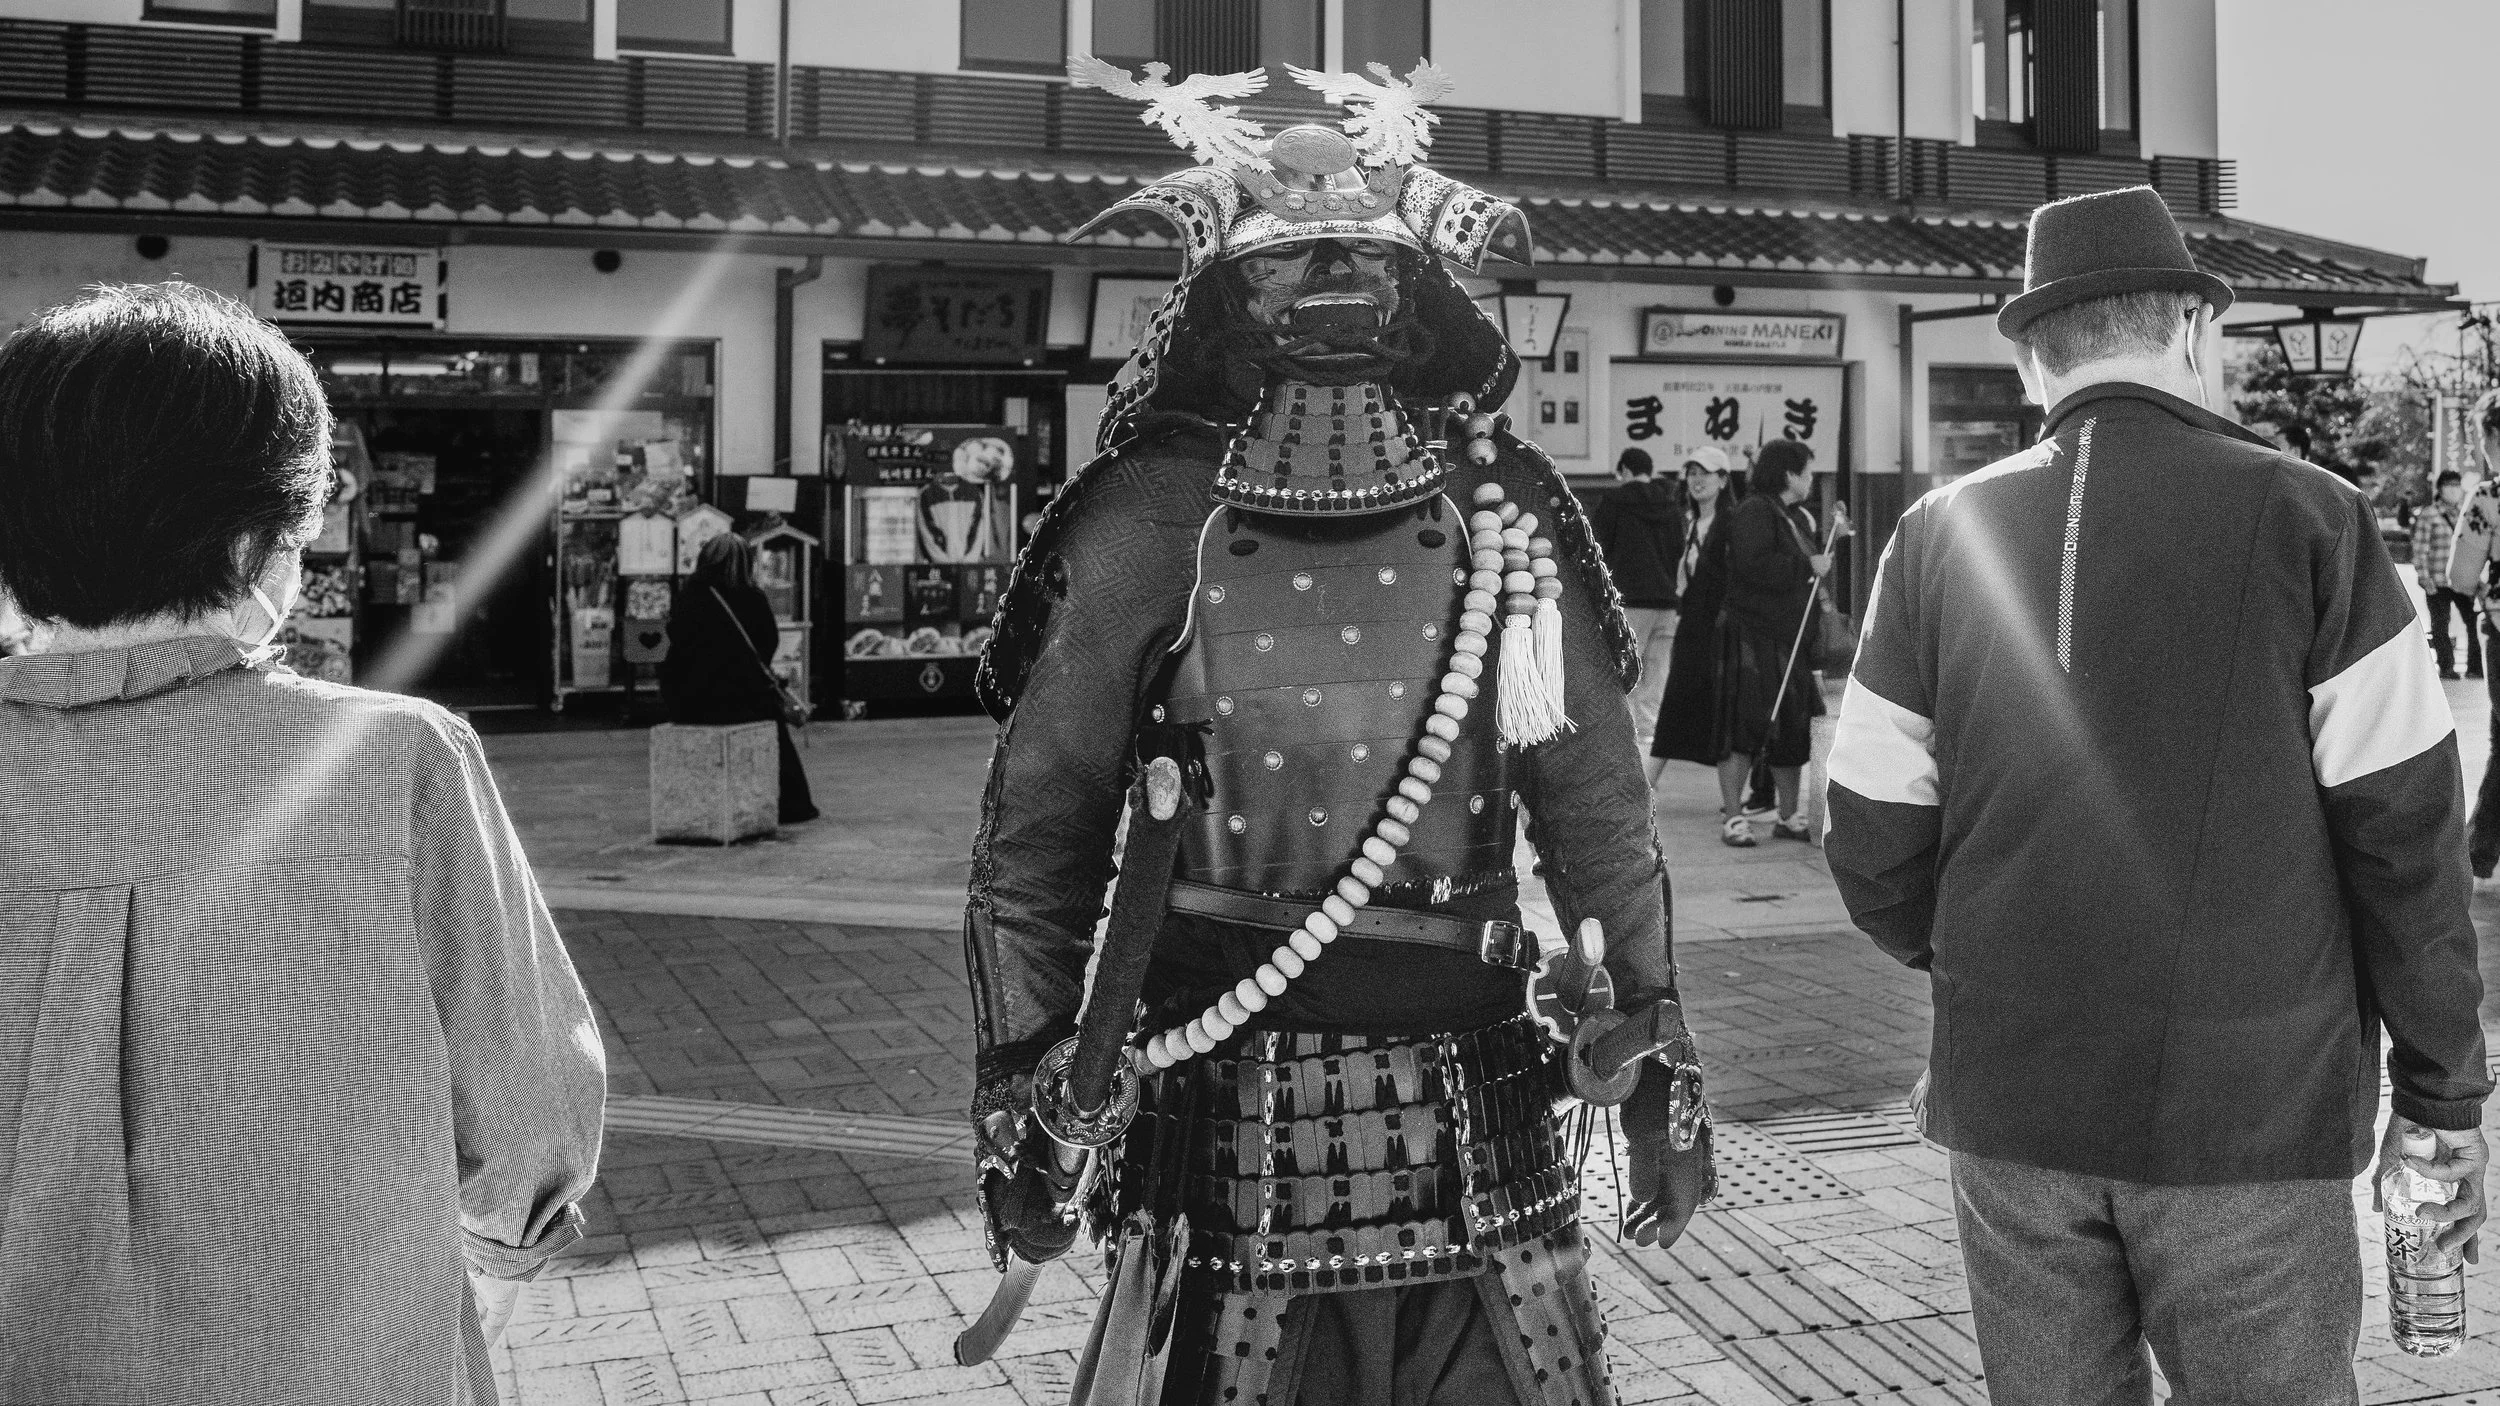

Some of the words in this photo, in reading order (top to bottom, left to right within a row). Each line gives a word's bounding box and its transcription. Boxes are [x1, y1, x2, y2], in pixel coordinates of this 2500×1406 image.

[1752, 323, 1832, 340] MANEKI
[1625, 394, 1819, 441] まねき
[2064, 435, 2091, 552] MIZUNO
